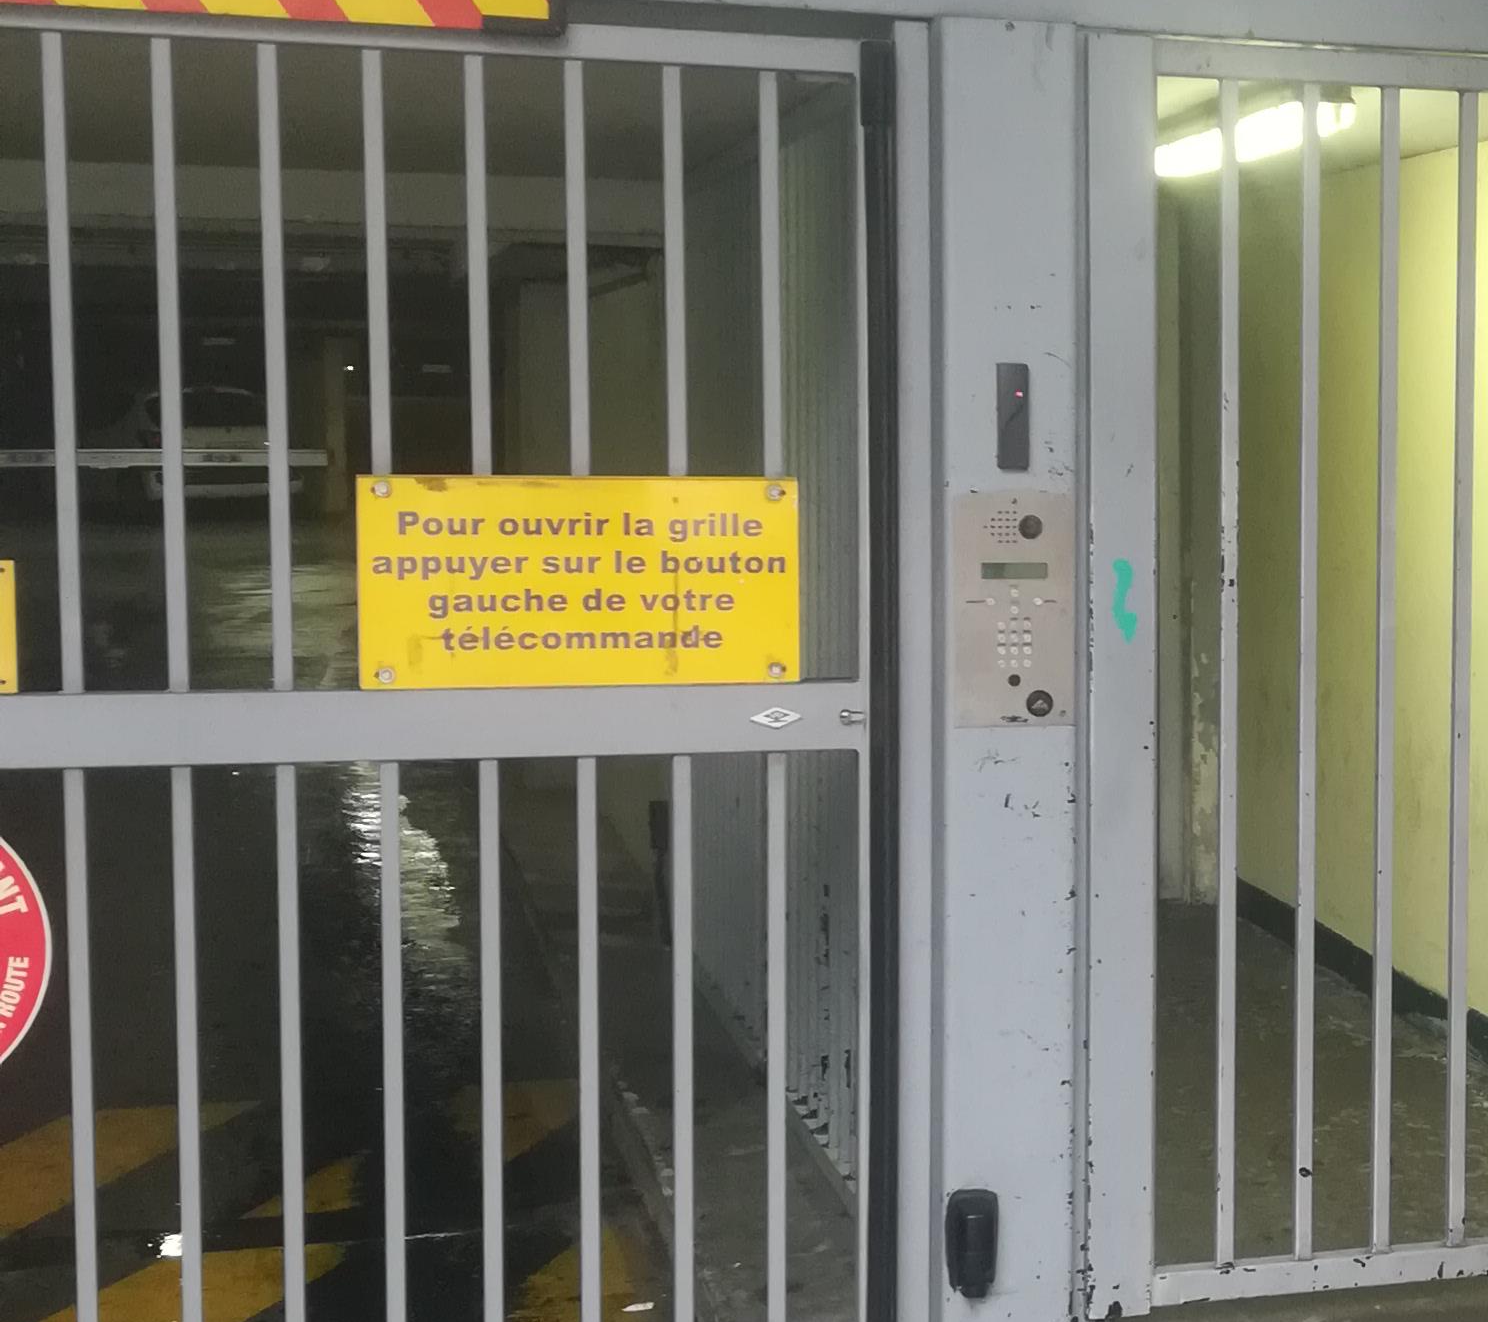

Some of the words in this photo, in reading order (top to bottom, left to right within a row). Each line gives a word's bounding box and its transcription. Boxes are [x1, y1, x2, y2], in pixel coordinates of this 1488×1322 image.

[397, 511, 485, 537] Pour
[498, 512, 609, 537] ouvrir
[623, 512, 655, 537] la
[669, 512, 763, 542] grille
[371, 553, 528, 580] appuyer
[542, 553, 601, 574] sur
[614, 550, 646, 574] le
[661, 550, 786, 574] bouton
[428, 588, 568, 619] gauche
[583, 588, 626, 612] de
[640, 590, 735, 612] votre
[442, 625, 723, 651] télécommande
[0, 861, 29, 915] NT
[0, 956, 30, 1019] ROUTE
